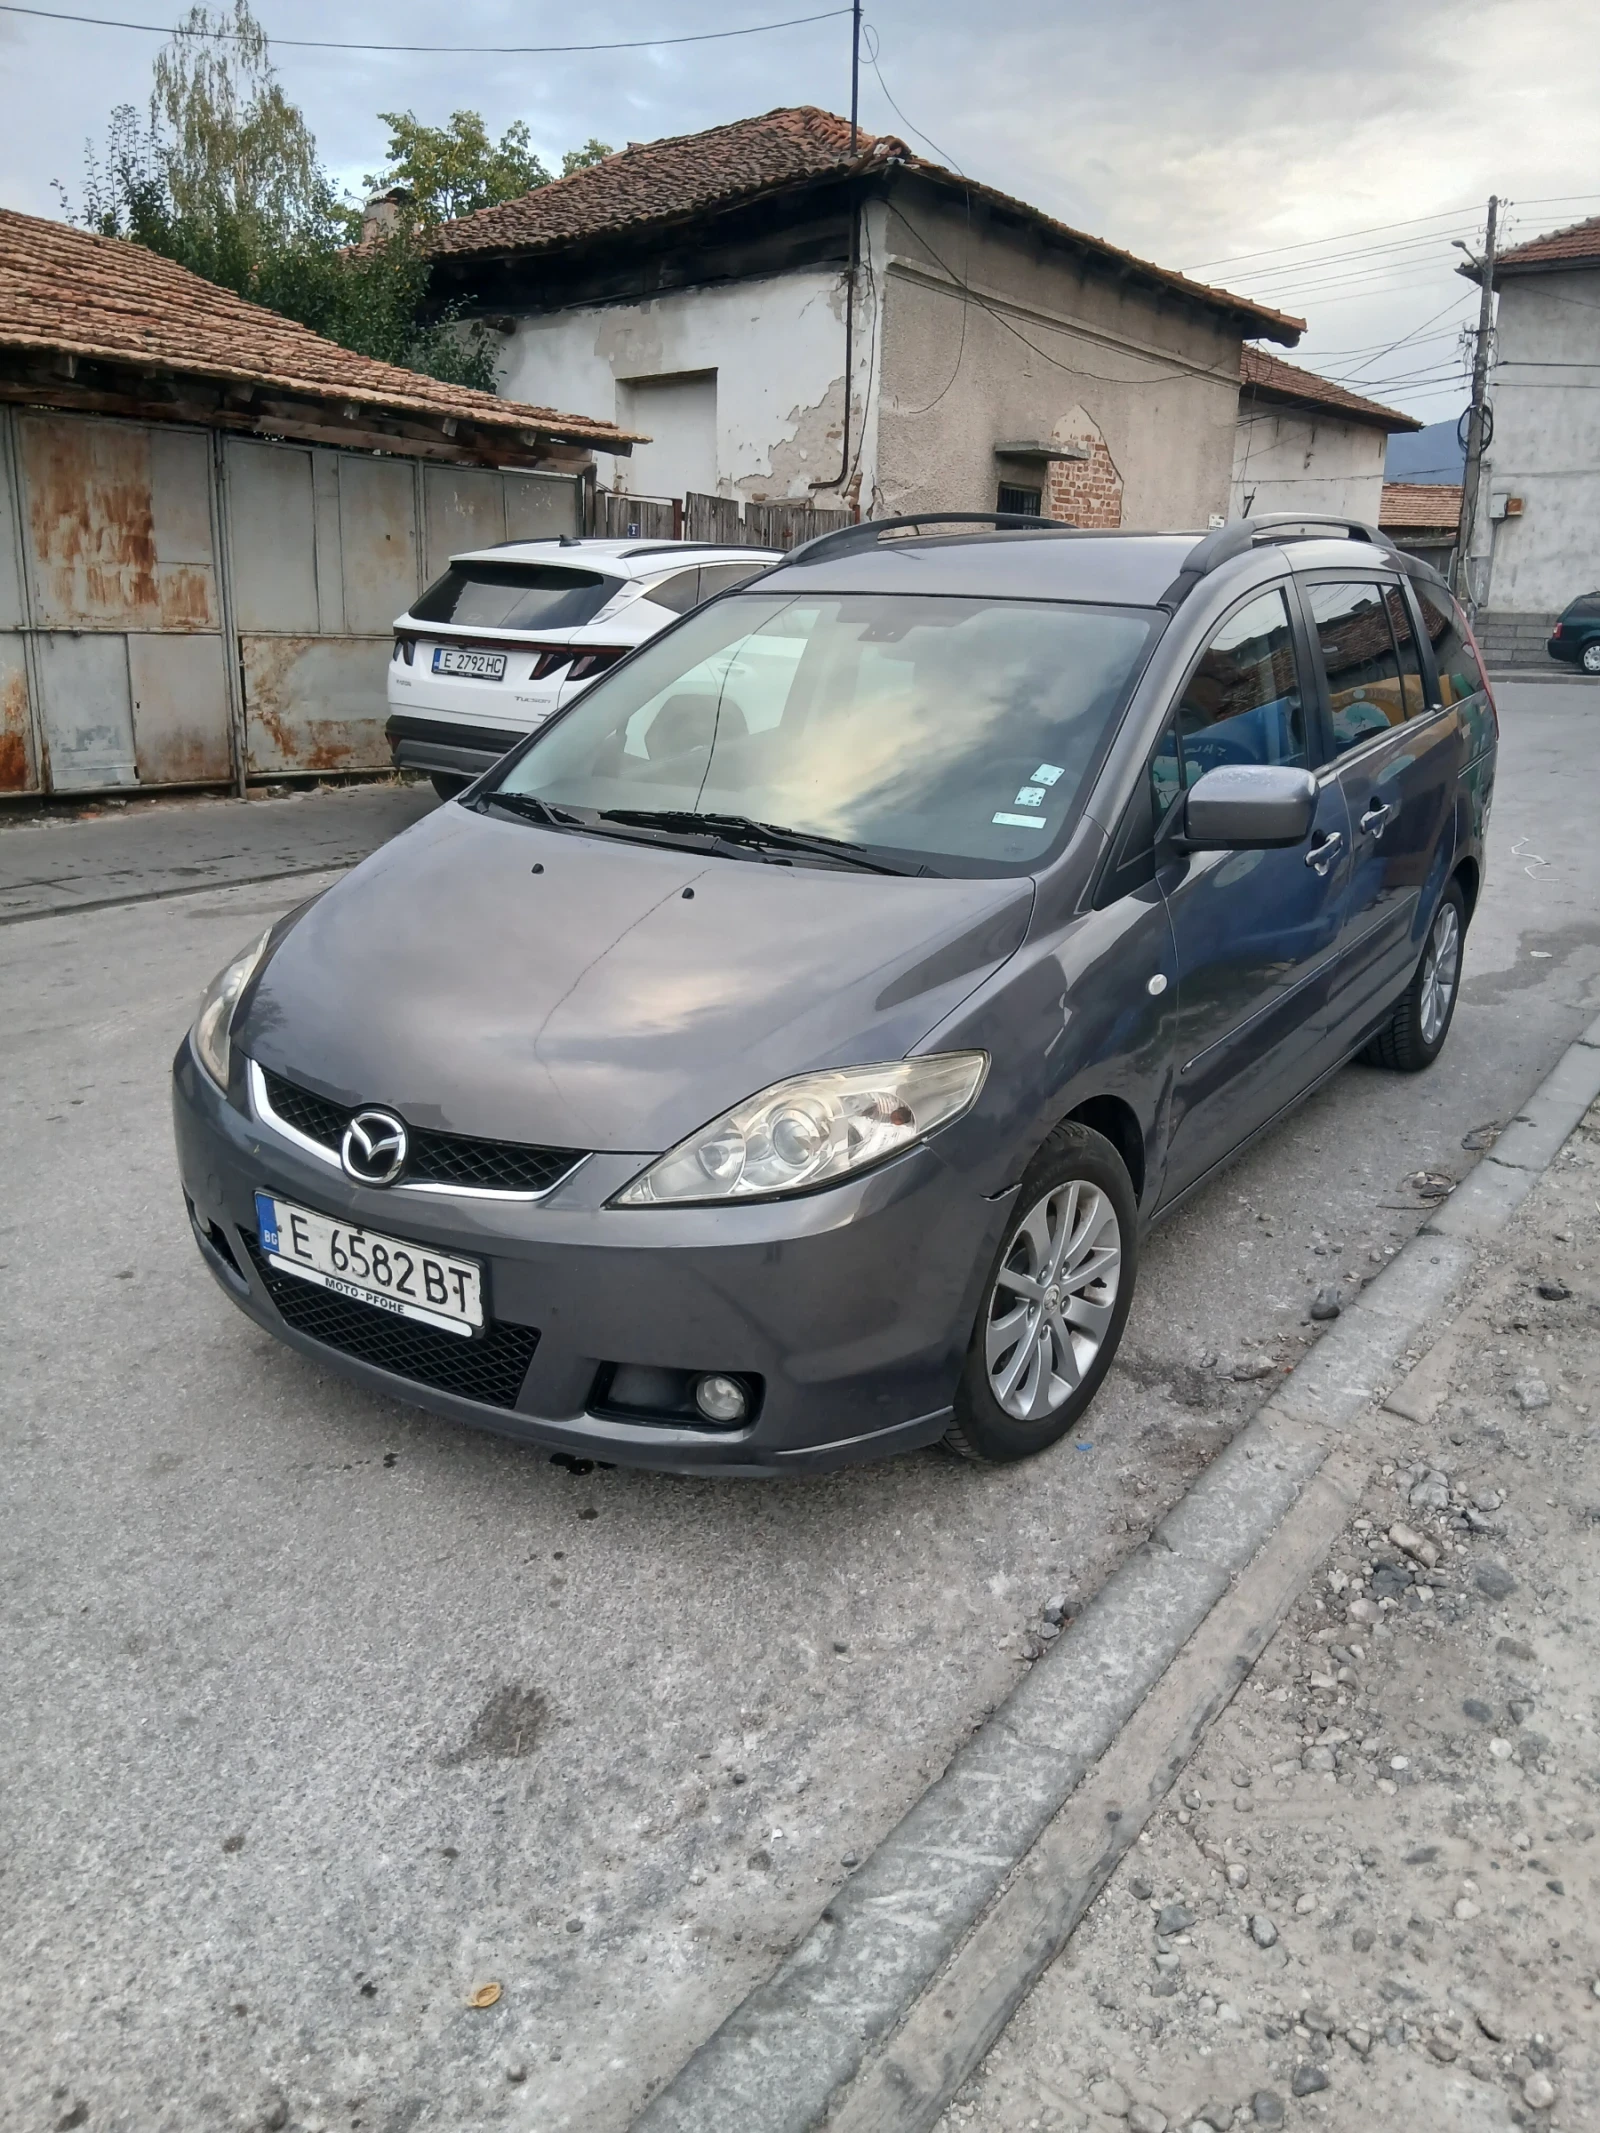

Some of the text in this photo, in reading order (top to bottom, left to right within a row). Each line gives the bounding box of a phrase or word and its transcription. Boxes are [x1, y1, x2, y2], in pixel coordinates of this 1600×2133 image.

[444, 653, 453, 668] E
[264, 1229, 278, 1246] BG
[290, 1213, 313, 1260] E
